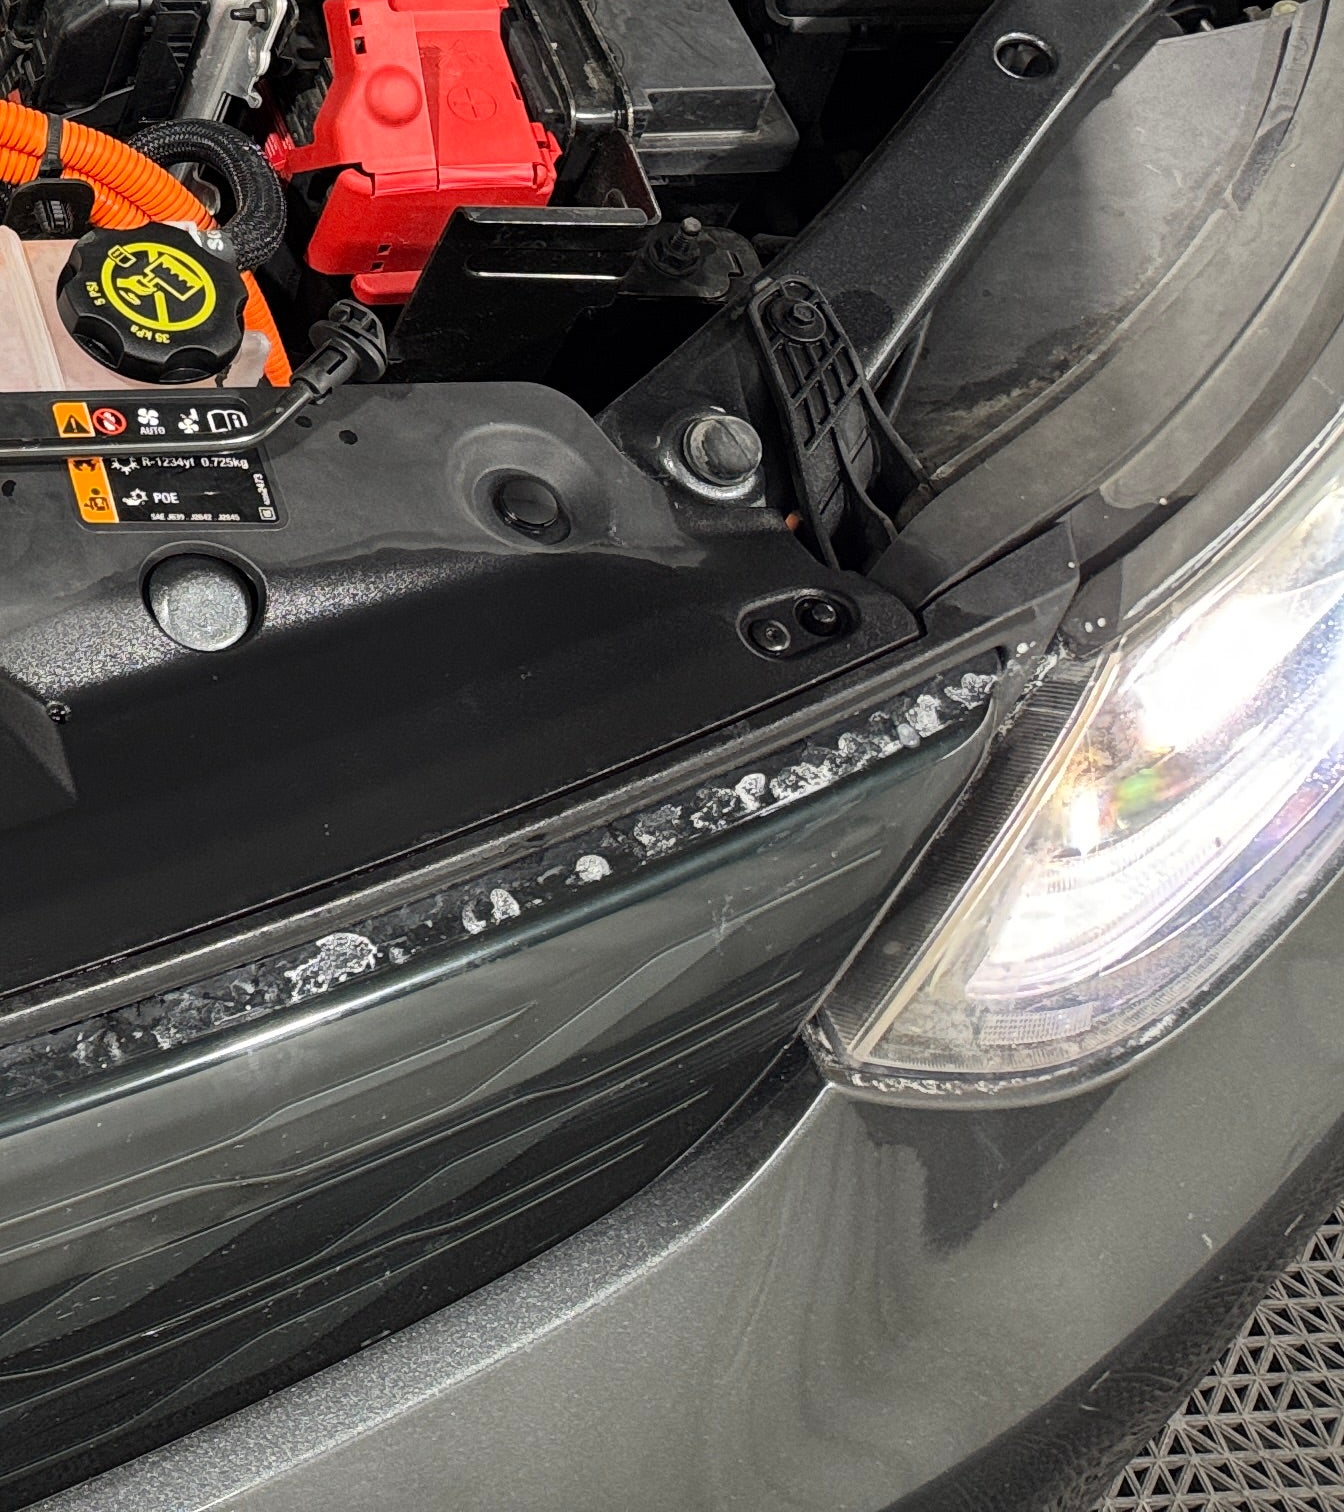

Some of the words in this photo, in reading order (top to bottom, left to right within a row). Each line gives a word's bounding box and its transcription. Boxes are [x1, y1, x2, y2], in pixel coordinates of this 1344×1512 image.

[85, 281, 101, 298] PSI
[94, 298, 106, 306] 5
[130, 324, 153, 341] kPa
[154, 332, 170, 344] 35
[140, 427, 165, 435] AUTO
[200, 458, 249, 469] 0.725kg
[153, 492, 179, 503] POE
[150, 513, 165, 521] SAE
